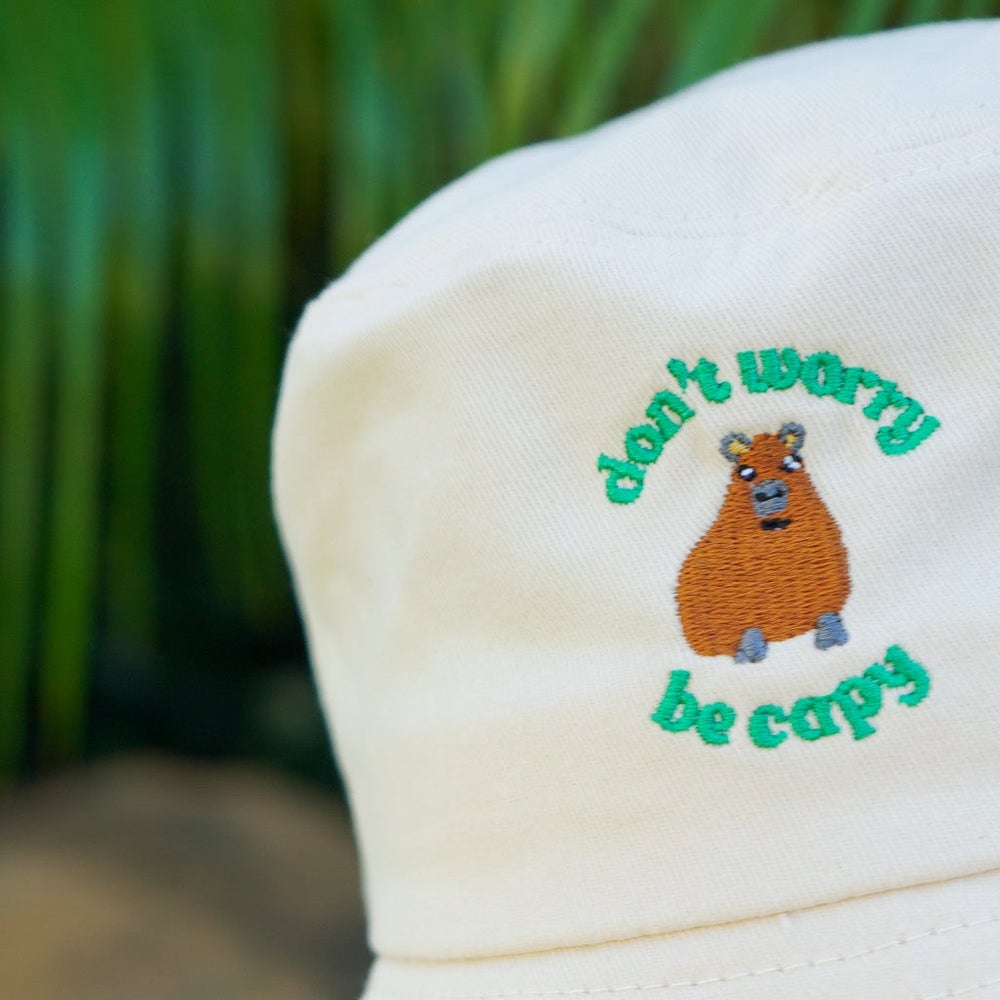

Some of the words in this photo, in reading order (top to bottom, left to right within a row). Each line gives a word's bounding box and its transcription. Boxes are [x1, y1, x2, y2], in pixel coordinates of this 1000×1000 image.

[597, 357, 732, 505] don't
[737, 347, 941, 456] worry
[651, 669, 737, 746] be
[748, 645, 932, 749] capy
